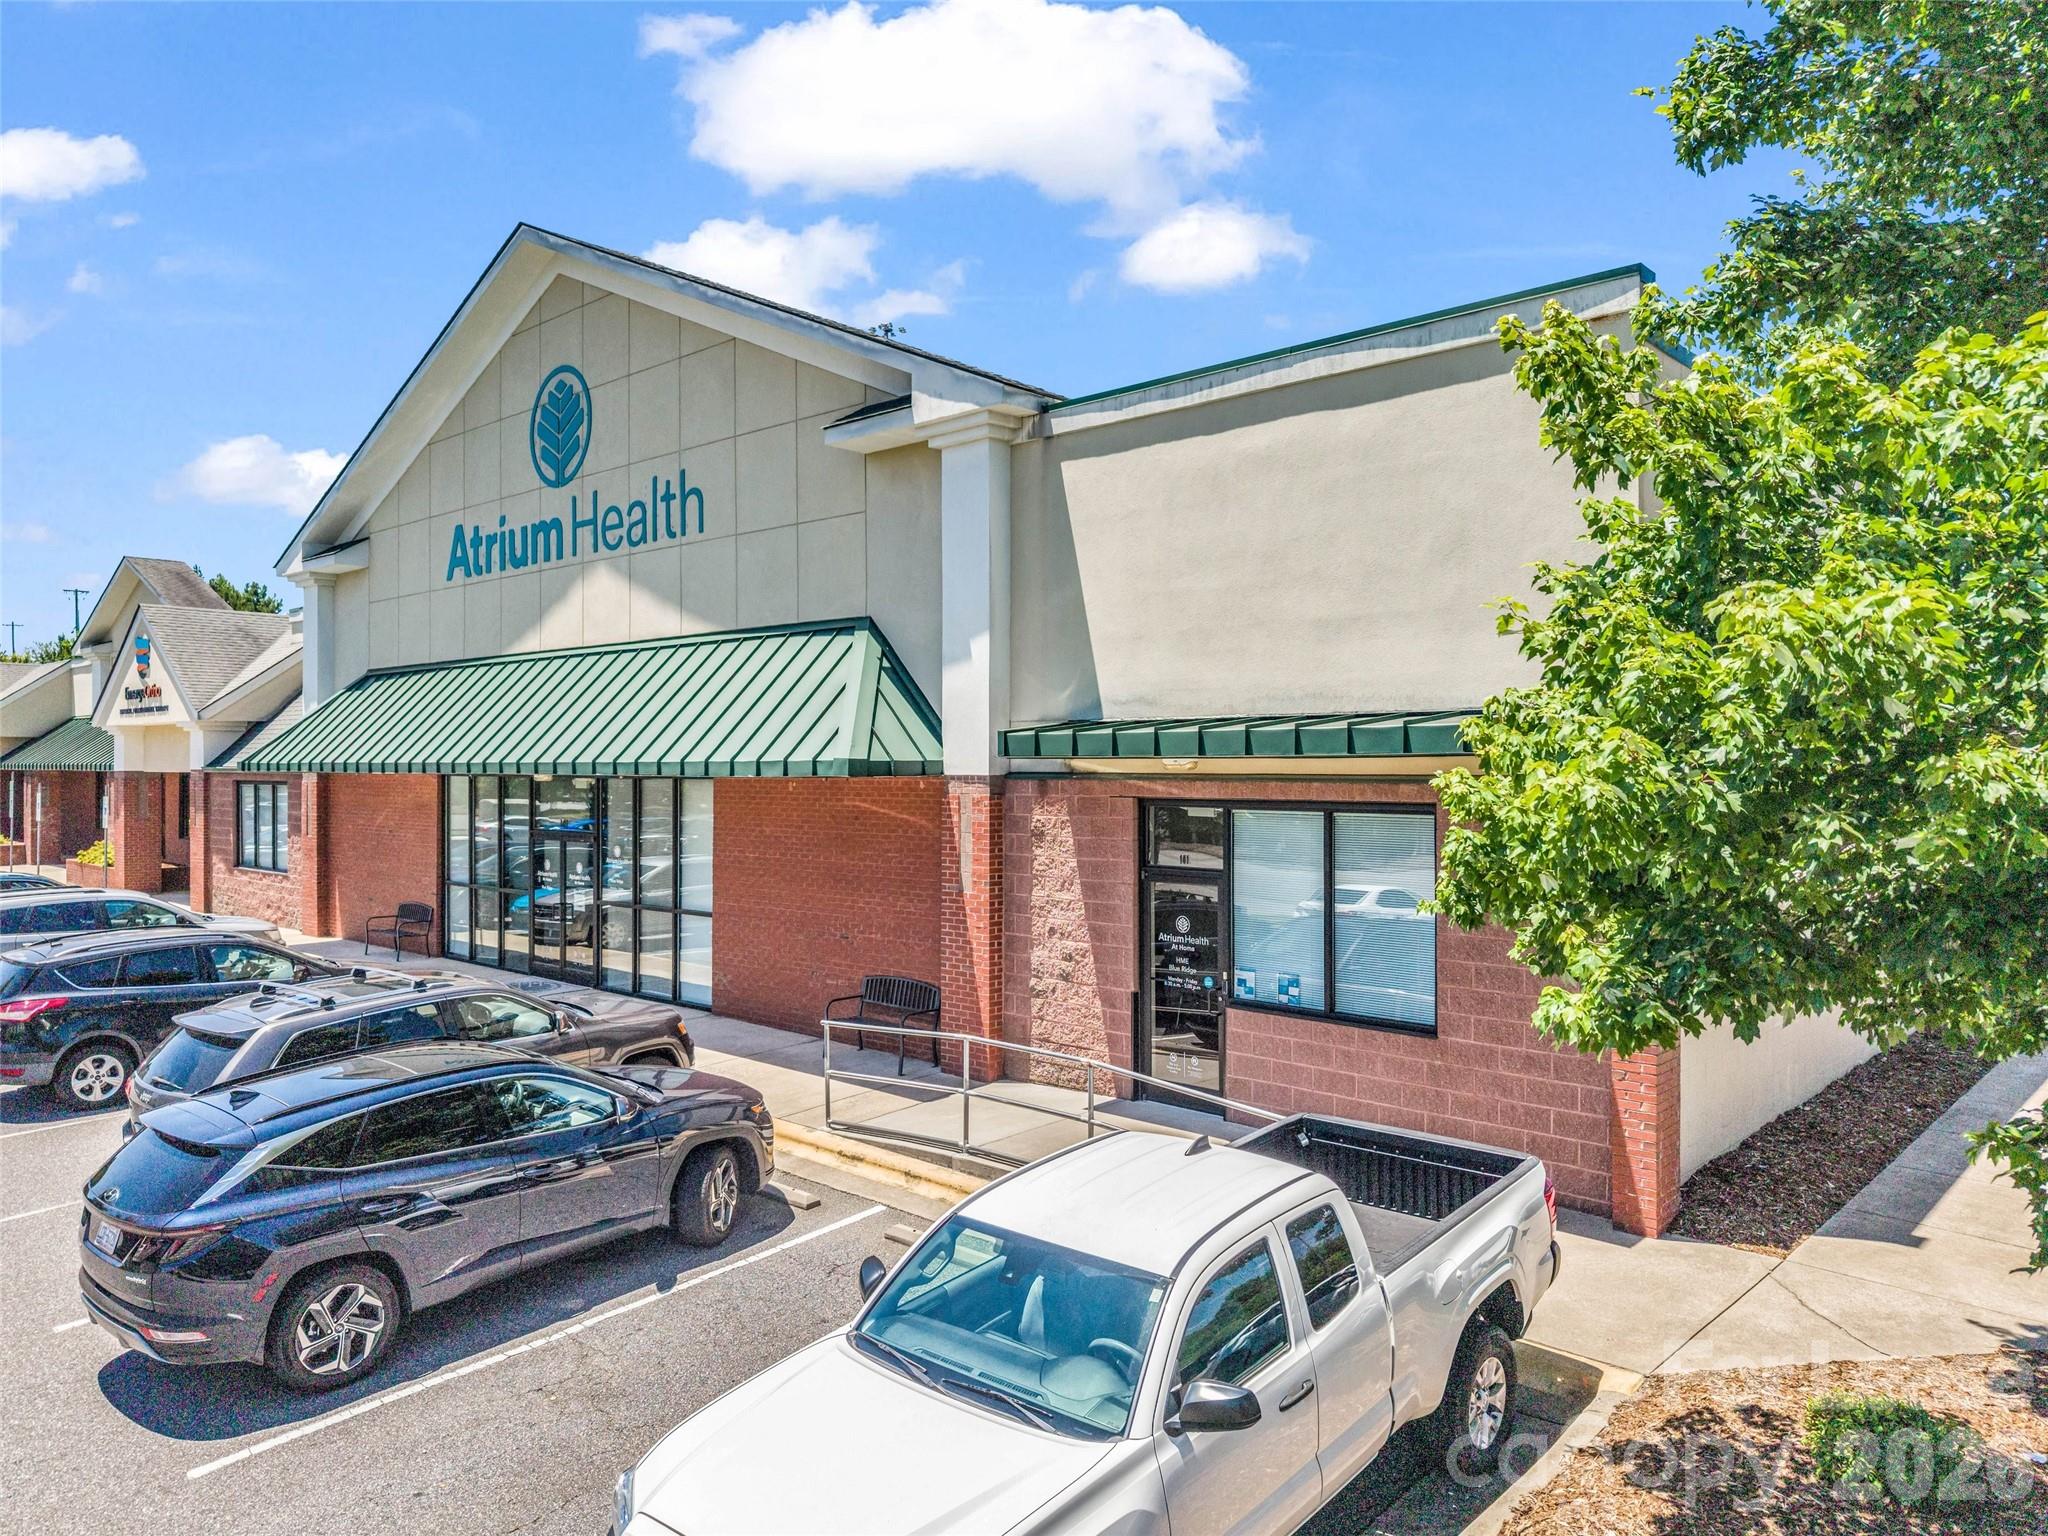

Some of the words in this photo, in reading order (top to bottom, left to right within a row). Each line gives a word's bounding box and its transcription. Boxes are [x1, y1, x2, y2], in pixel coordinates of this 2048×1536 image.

[446, 514, 564, 581] Atrium
[571, 468, 705, 557] Health
[1158, 932, 1184, 943] Atrium
[1184, 934, 1209, 945] Health
[1175, 956, 1189, 964] HME
